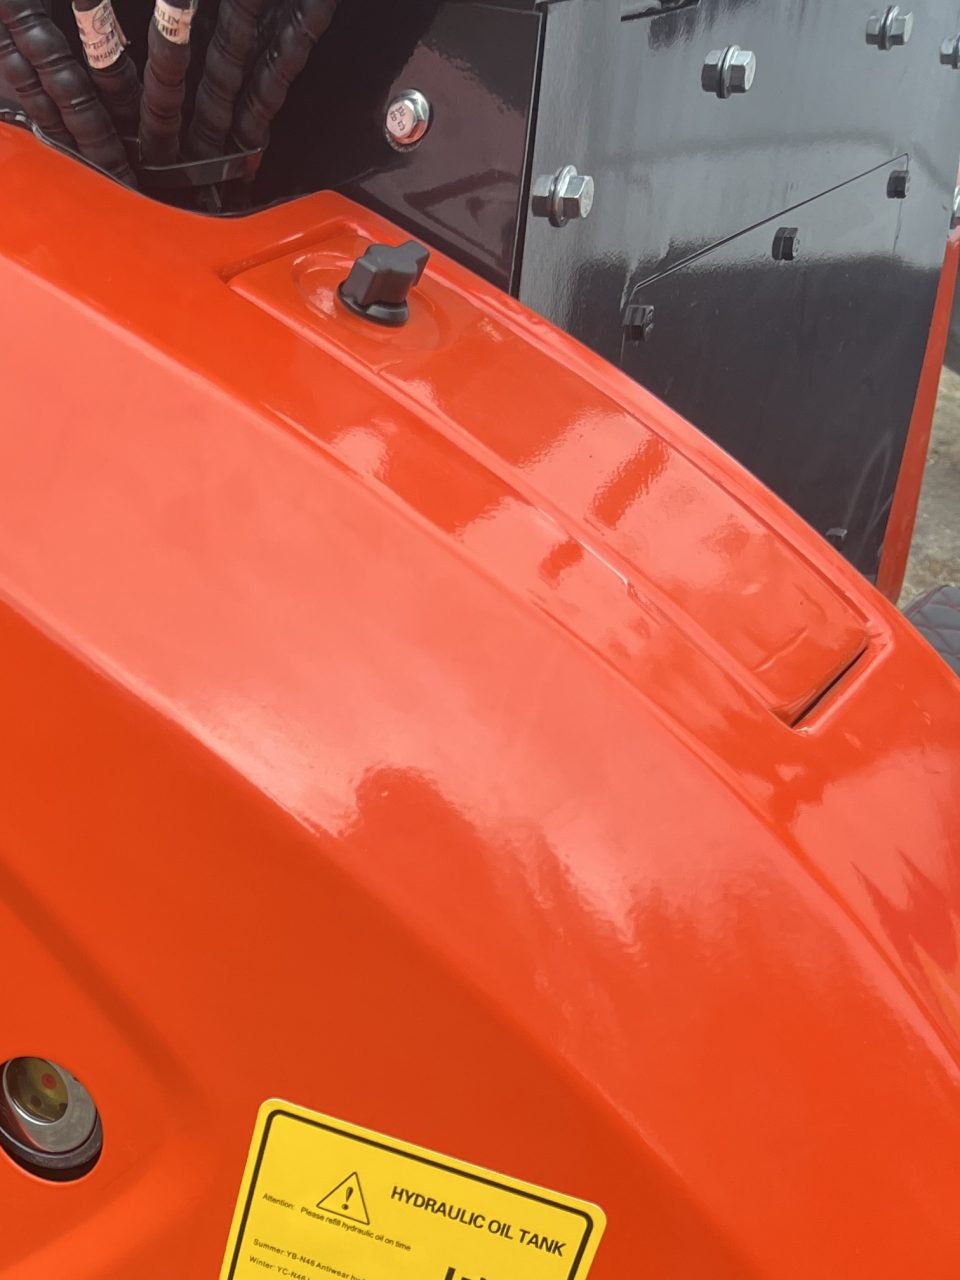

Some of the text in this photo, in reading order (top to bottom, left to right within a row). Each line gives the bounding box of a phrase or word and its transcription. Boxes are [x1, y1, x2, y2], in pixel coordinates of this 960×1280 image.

[300, 1206, 325, 1221] Please
[341, 1221, 375, 1238] hydraulic
[374, 1234, 385, 1242] oil
[384, 1238, 394, 1246] on
[395, 1240, 411, 1251] time
[390, 1186, 567, 1257] HYDRAULIC OIL TANK
[315, 1262, 349, 1279] Antiwear
